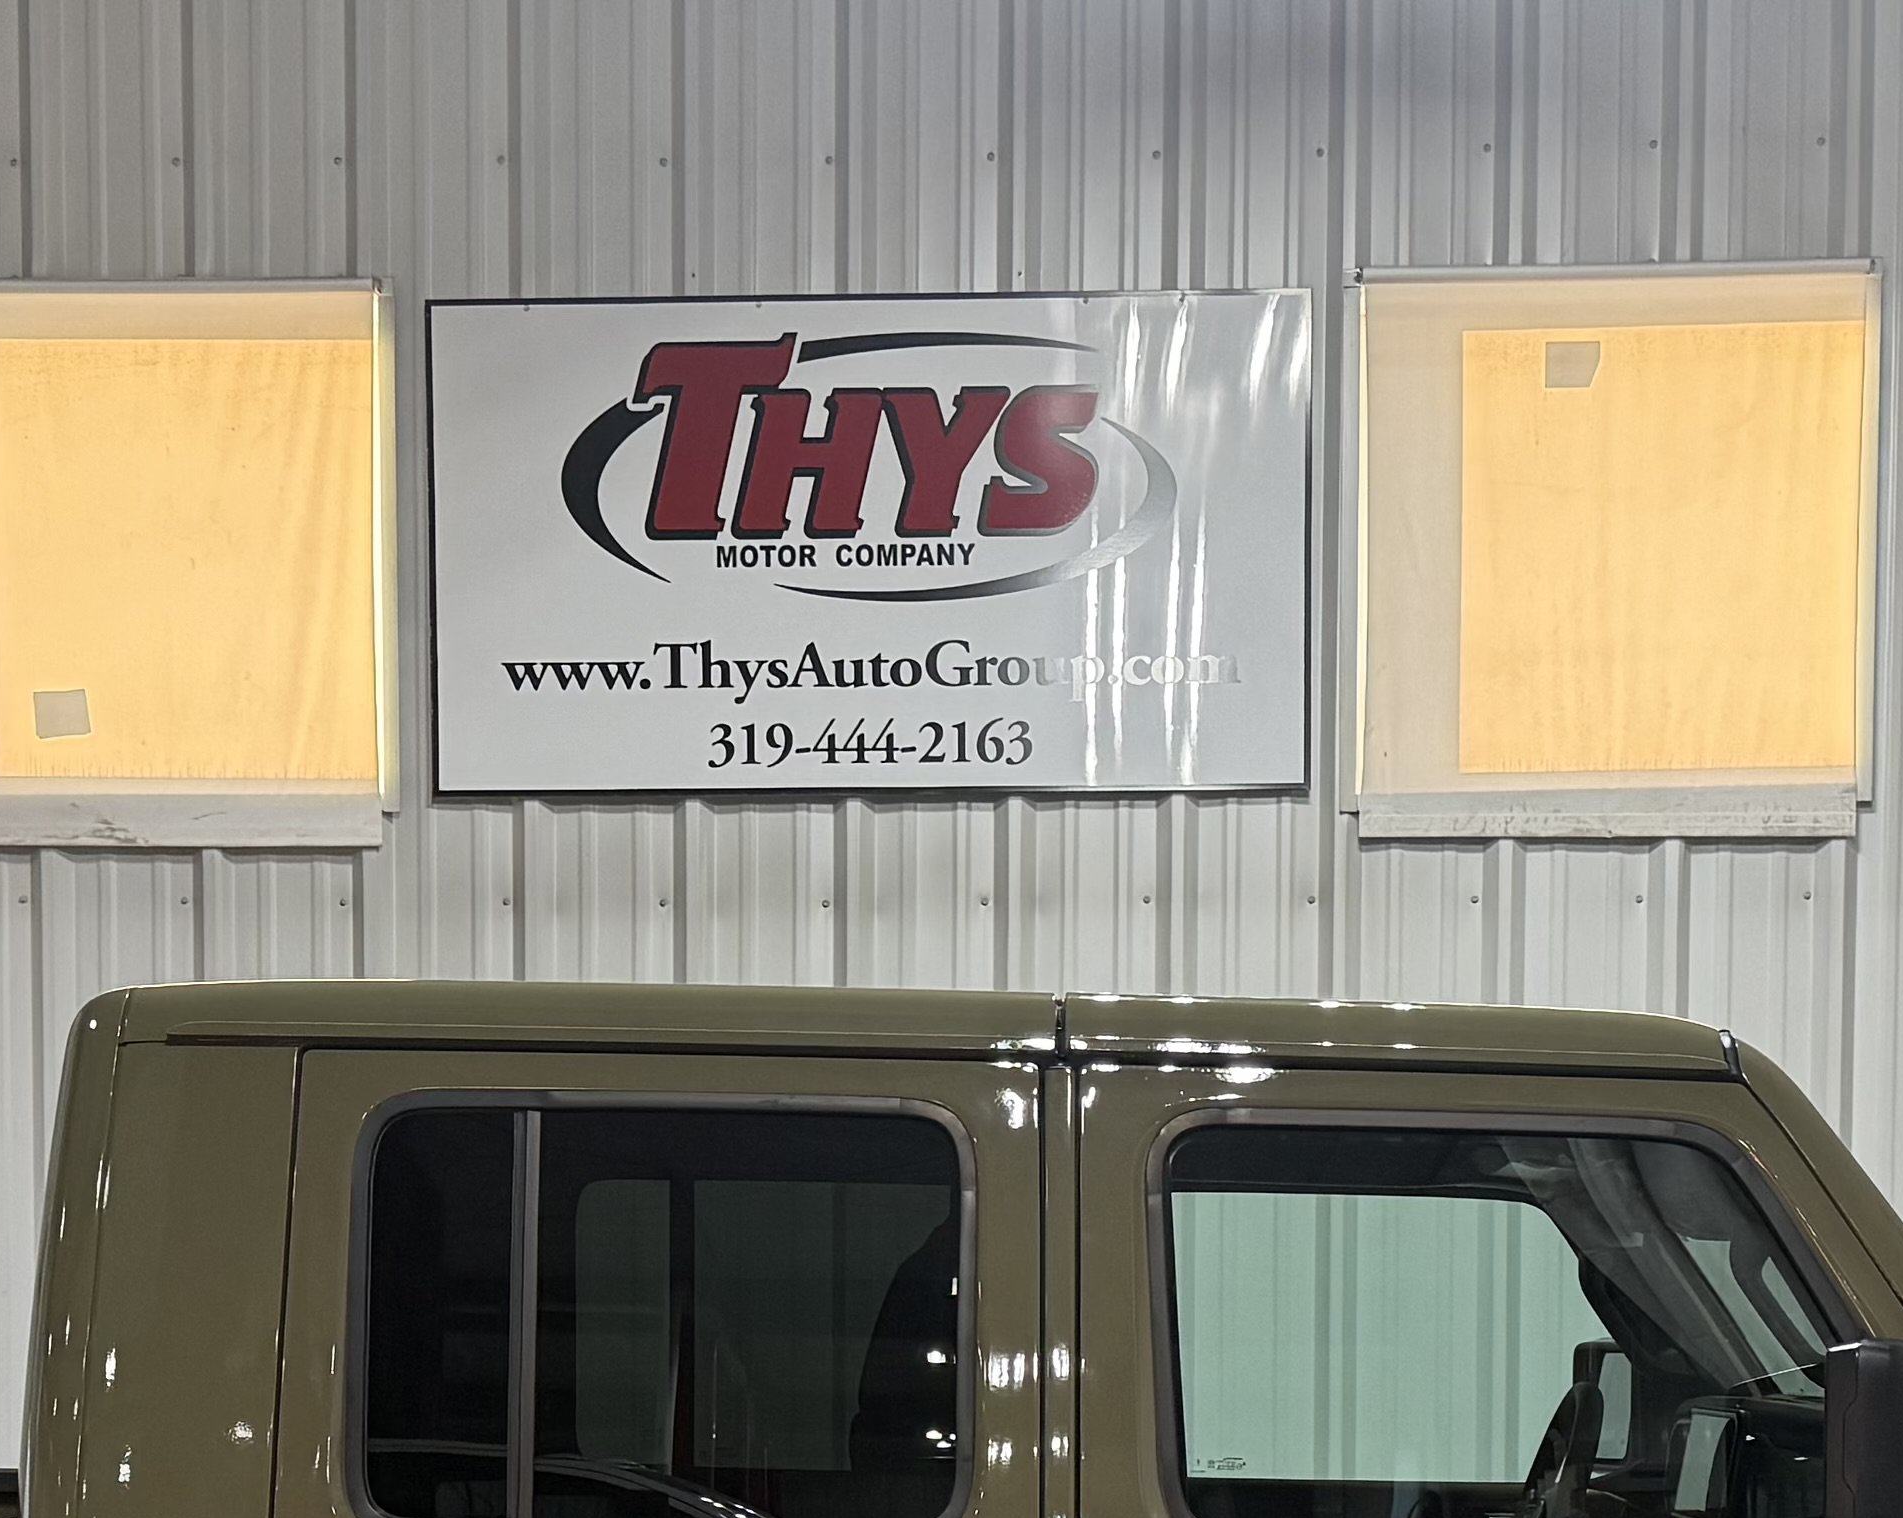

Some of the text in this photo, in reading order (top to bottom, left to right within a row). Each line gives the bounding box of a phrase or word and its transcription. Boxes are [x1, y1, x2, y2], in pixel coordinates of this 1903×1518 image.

[634, 332, 1100, 540] THYS
[716, 543, 976, 569] MOTOR COMPANY
[502, 640, 1243, 703] www.ThysAutoGroup.com
[708, 717, 1034, 769] 319-444-2163
